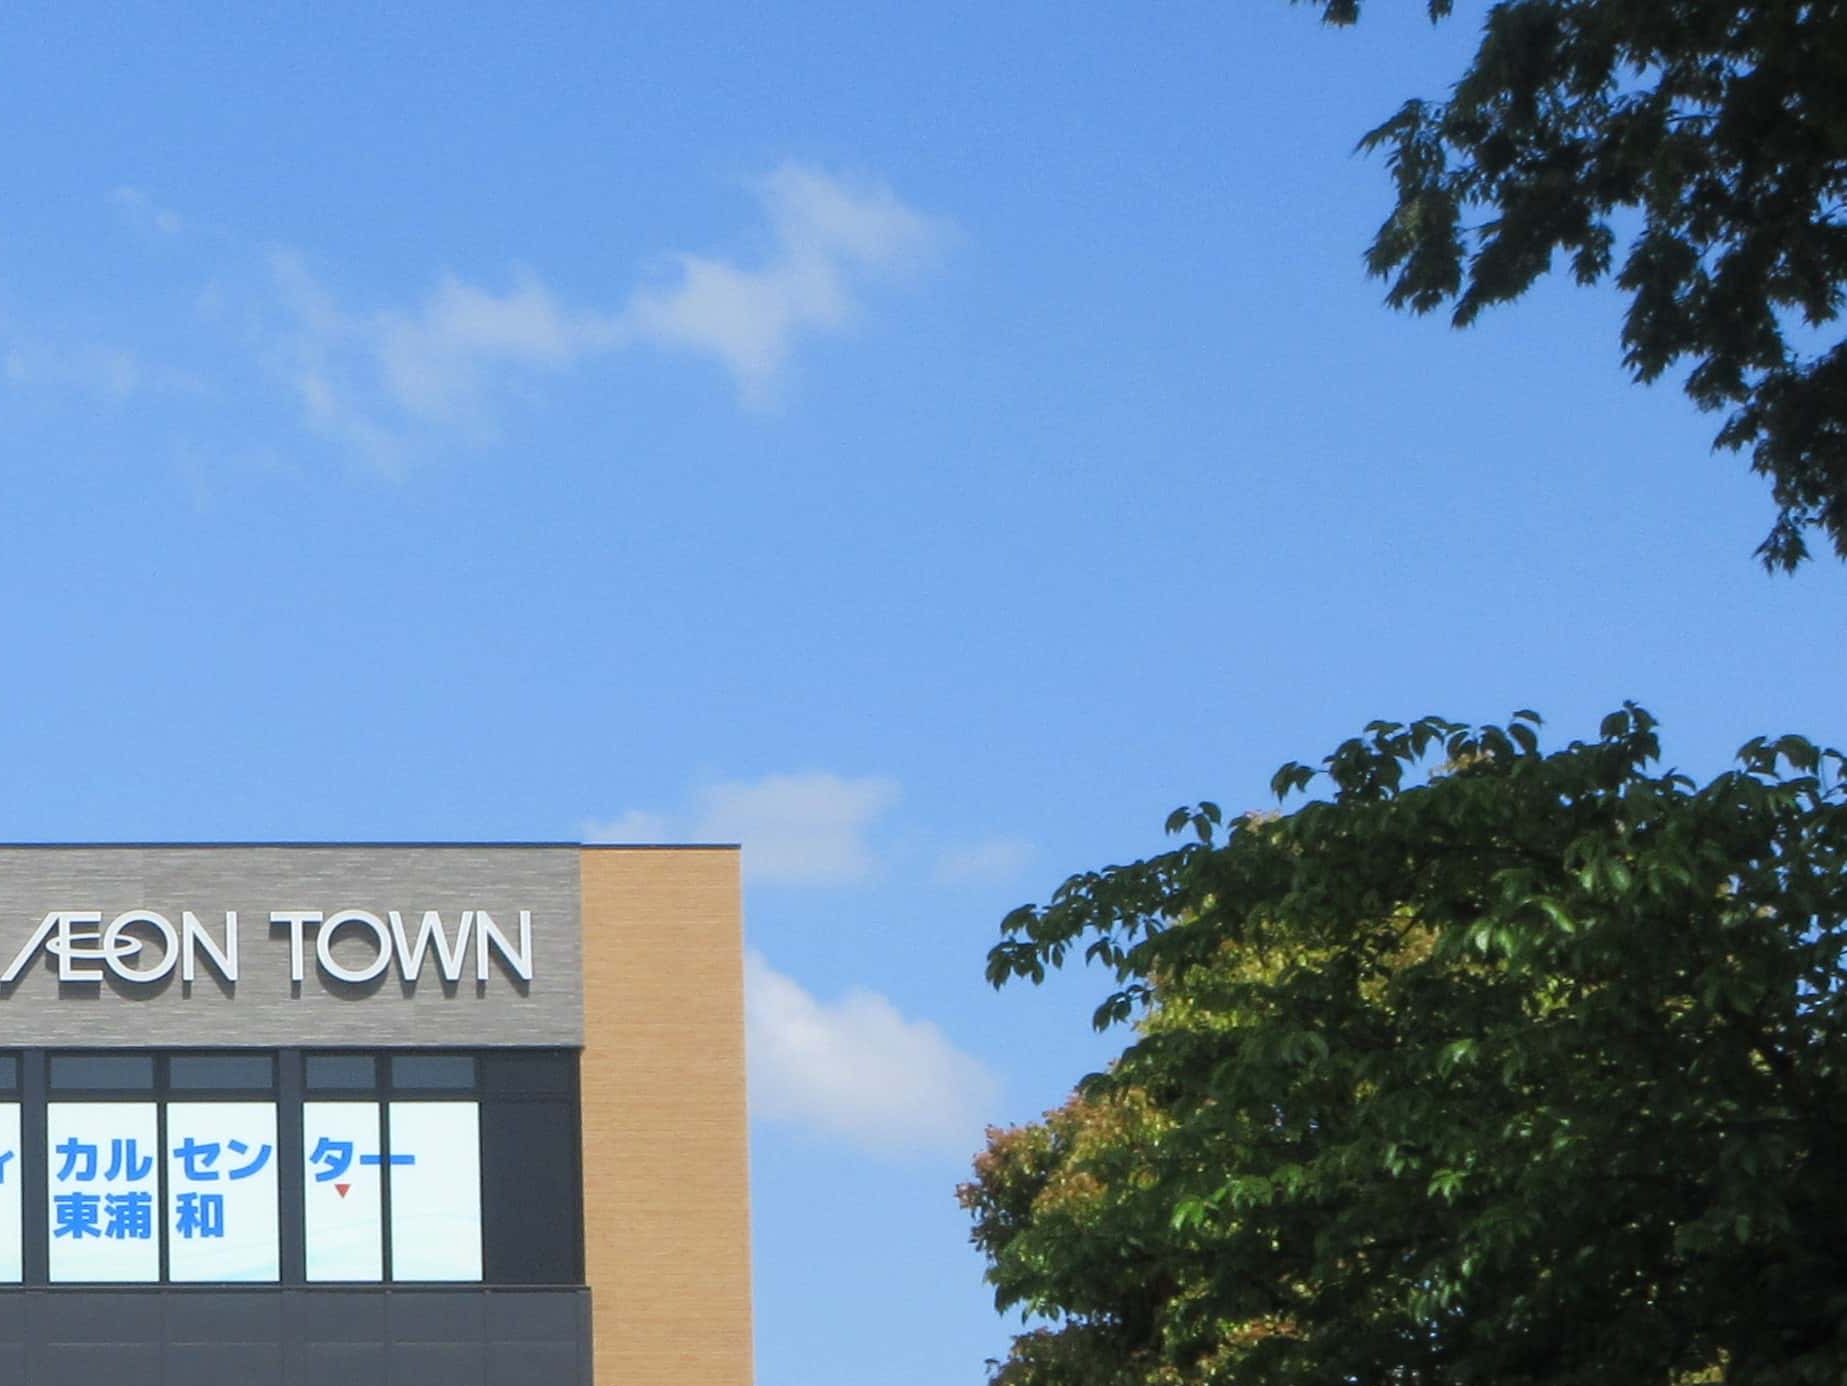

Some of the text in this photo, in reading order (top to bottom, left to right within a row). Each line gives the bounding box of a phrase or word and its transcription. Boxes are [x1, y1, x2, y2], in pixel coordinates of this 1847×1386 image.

[269, 909, 534, 984] TOWN
[53, 1191, 225, 1240] 東浦和
